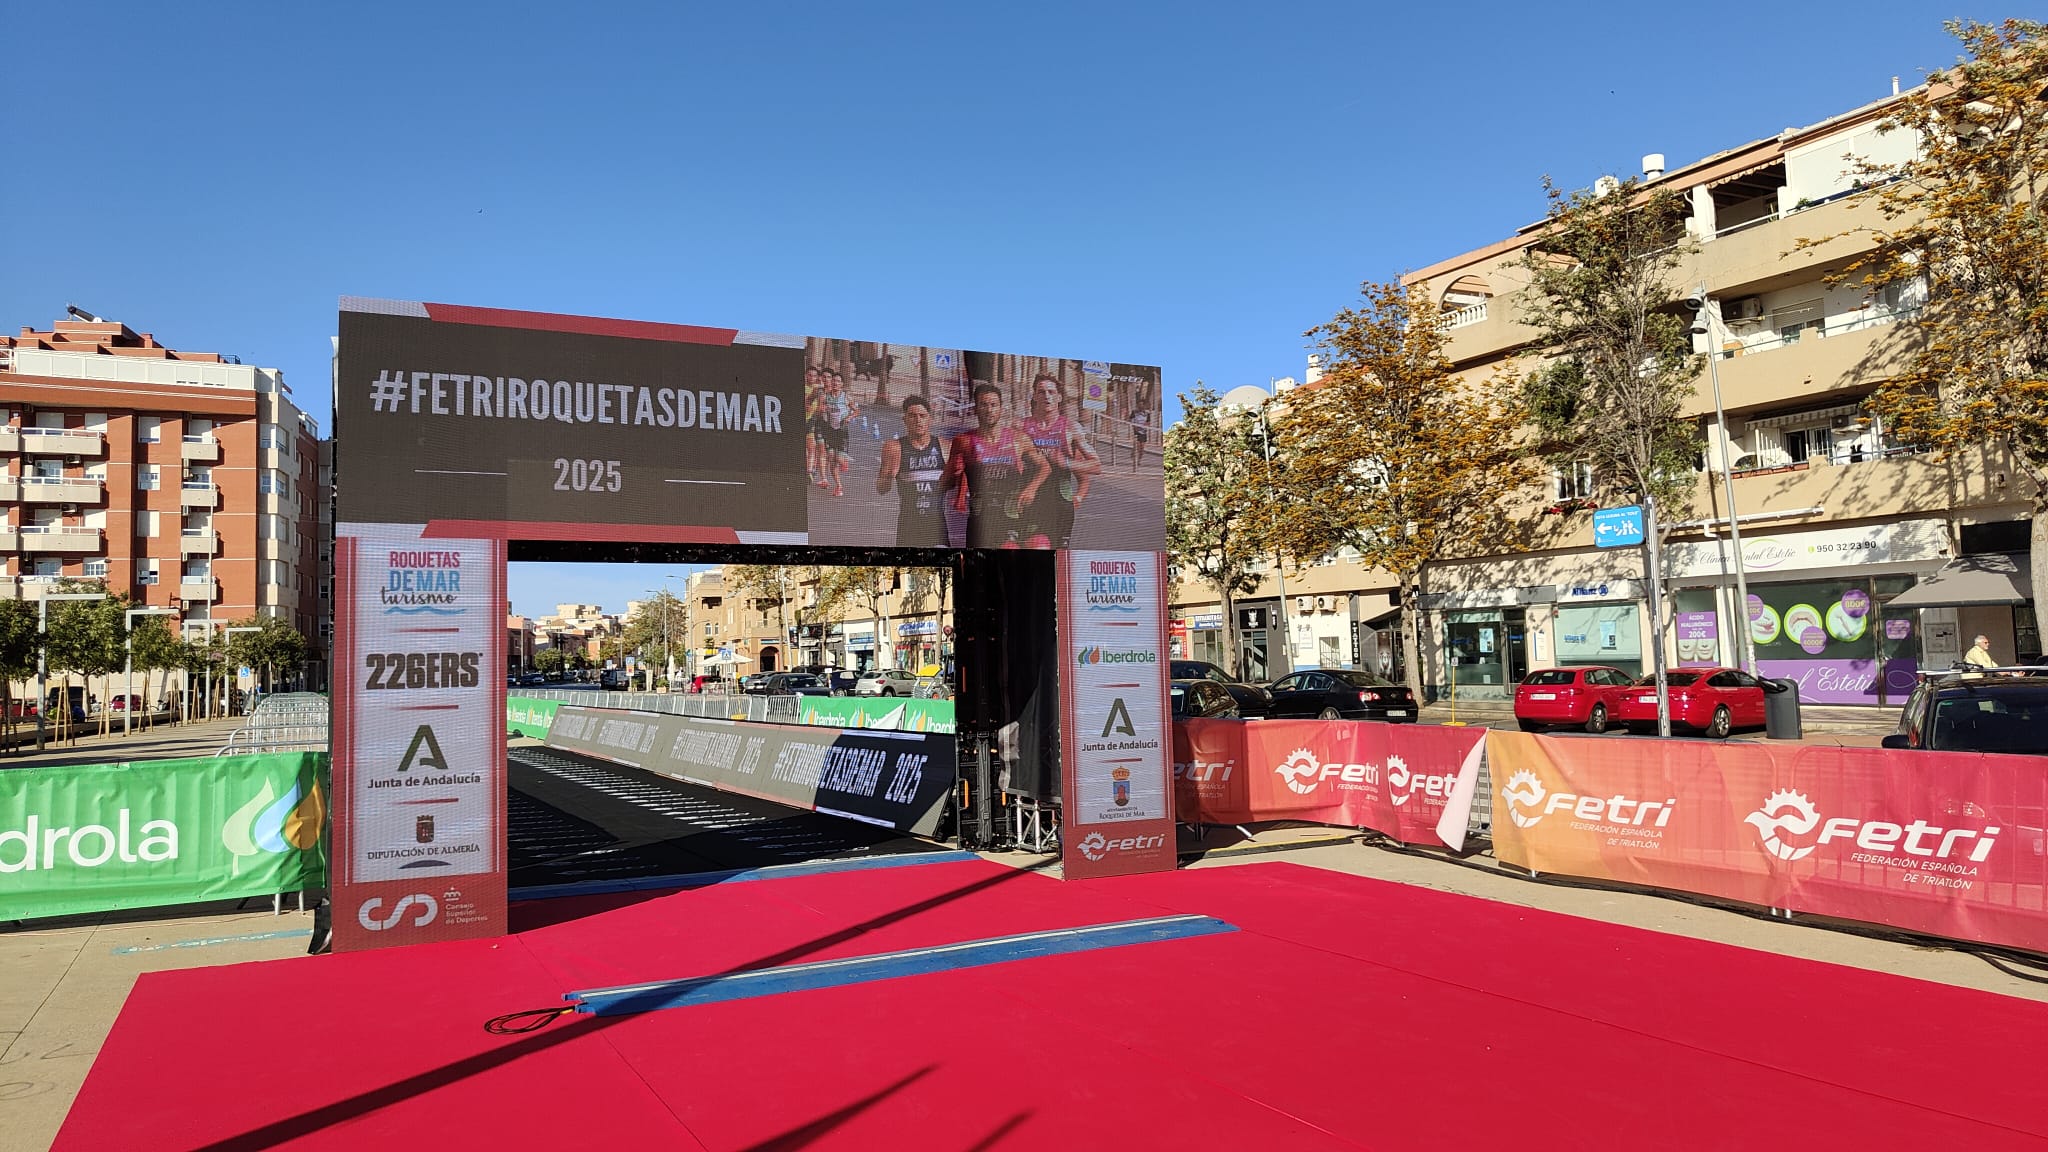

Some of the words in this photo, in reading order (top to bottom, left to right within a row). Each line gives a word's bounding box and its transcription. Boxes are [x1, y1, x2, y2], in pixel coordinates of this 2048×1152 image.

[370, 369, 782, 433] #FETRIROQUETASDEMAR
[553, 457, 622, 493] 2025
[1816, 545, 1834, 553] 950
[1837, 543, 1847, 551] 32
[1850, 542, 1862, 550] 23
[1864, 541, 1877, 549] 90
[389, 551, 460, 568] ROQUETAS
[1090, 561, 1136, 575] ROQUETAS
[390, 570, 412, 592] DE
[416, 570, 461, 592] MAR
[1091, 576, 1106, 593] DE
[1108, 576, 1137, 593] MAR
[380, 585, 458, 605] turismo
[1085, 588, 1136, 604] turismo
[1688, 630, 1706, 638] 200€
[366, 652, 480, 690] 226ERS
[1082, 742, 1106, 752] Junta
[1107, 742, 1118, 750] de
[1119, 739, 1158, 750] Andalucía
[368, 778, 402, 789] Junta
[405, 777, 420, 787] de
[422, 772, 481, 786] Andalucía
[884, 753, 928, 804] 2025
[1620, 827, 1663, 839] ESPAÑOLA
[367, 847, 425, 860] DIPUTACIÓN
[427, 847, 439, 856] DE
[440, 843, 480, 855] ALMERÍA
[1607, 838, 1618, 846] DE
[1619, 839, 1660, 849] TRIATLÓN
[1850, 852, 1919, 869] FEDERACIÓN
[1920, 860, 1977, 877] ESPAÑOLA
[1902, 872, 1919, 883] DE
[1921, 874, 1973, 890] TRIATLÓN
